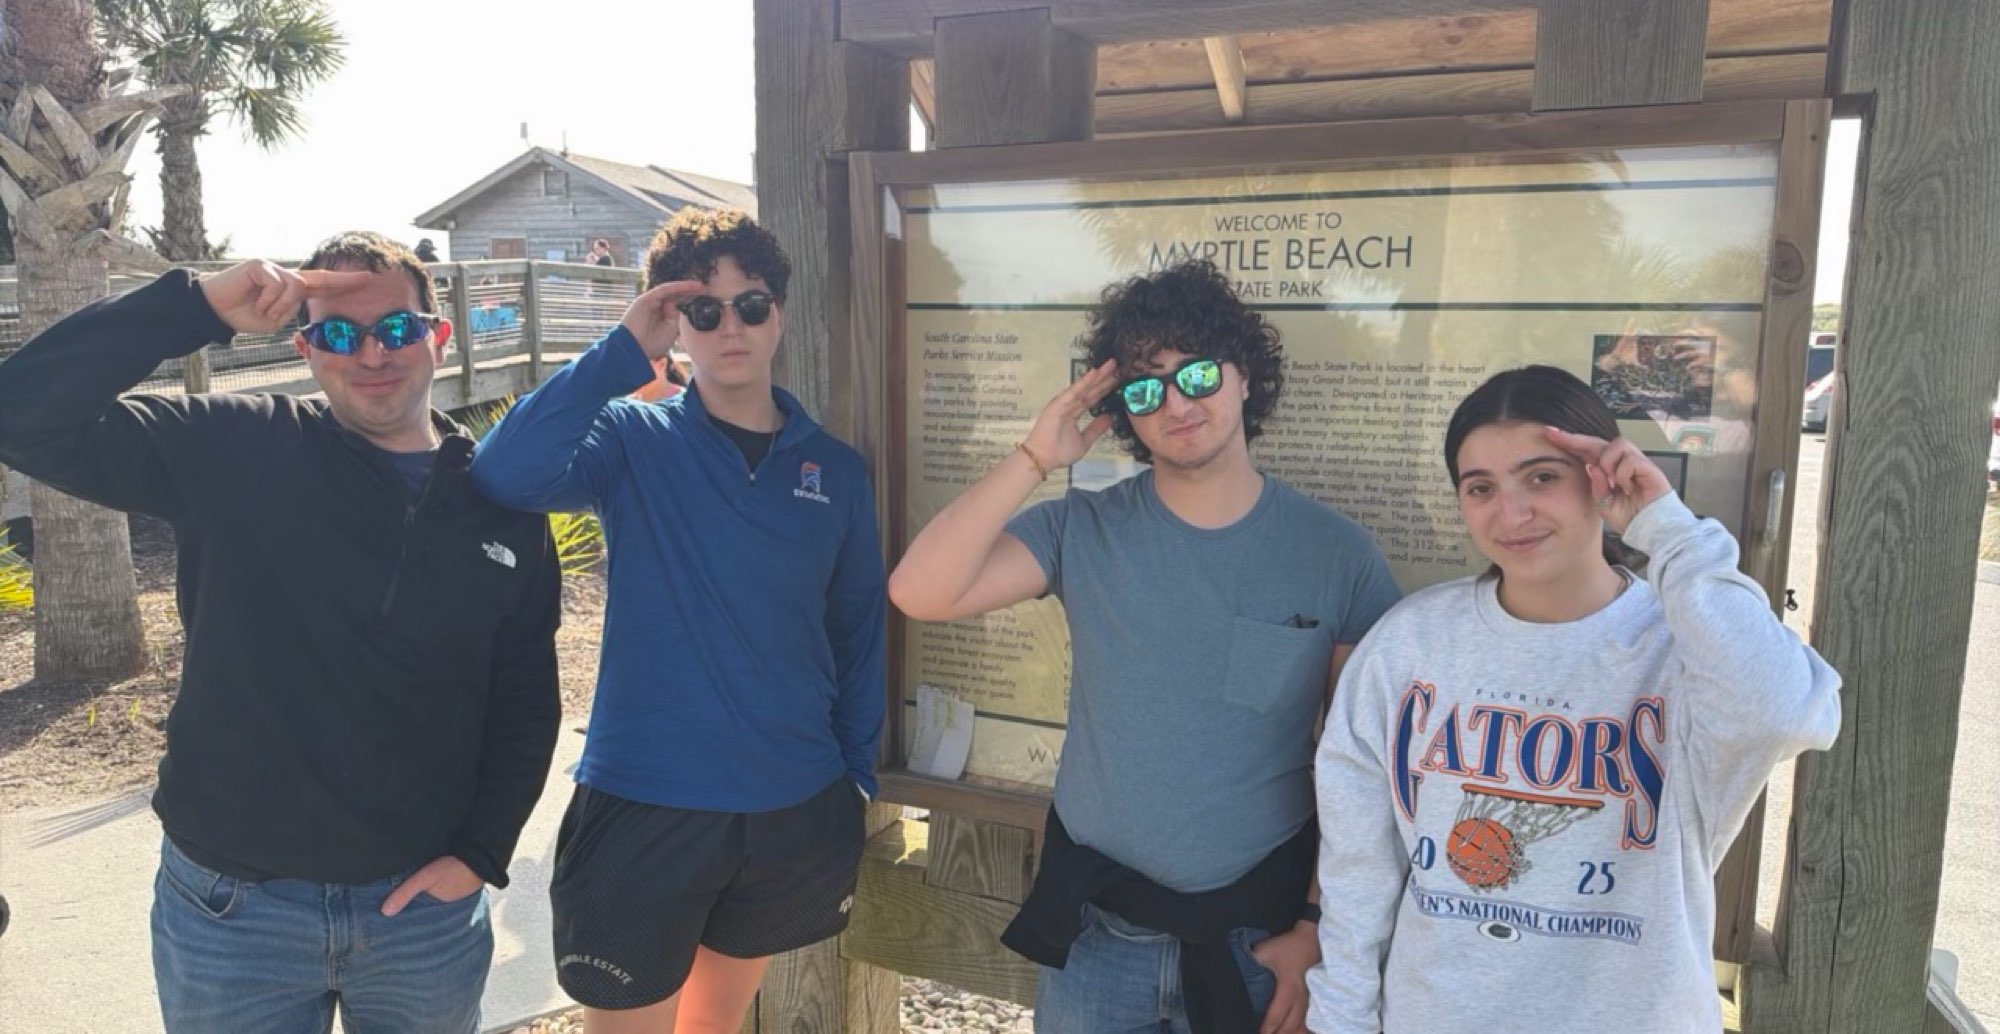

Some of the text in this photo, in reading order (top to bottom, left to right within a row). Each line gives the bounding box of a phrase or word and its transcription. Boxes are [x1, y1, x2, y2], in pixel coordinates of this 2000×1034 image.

[1215, 211, 1343, 232] WELCOME TO
[1285, 234, 1414, 271] BEACH
[1226, 279, 1324, 298] TATE PARK
[925, 332, 1020, 345] South Carolina State
[924, 348, 1023, 362] Parks Service Mission
[1291, 360, 1321, 371] Beach
[1324, 361, 1348, 371] State
[1350, 361, 1371, 372] Park
[1375, 362, 1384, 372] is
[1387, 361, 1423, 373] located
[1426, 362, 1436, 373] in
[1440, 361, 1456, 373] the
[1458, 361, 1486, 374] heart
[934, 371, 975, 382] encourage
[977, 372, 1005, 382] people
[1288, 374, 1310, 386] busy
[1312, 374, 1345, 386] Grand
[1385, 375, 1401, 387] but
[1413, 375, 1431, 388] still
[1433, 377, 1468, 389] retains
[957, 383, 977, 393] South
[982, 384, 1023, 395] Carolina's
[1332, 388, 1387, 402] Designated
[1400, 389, 1443, 403] Heritage
[943, 397, 965, 407] parks
[966, 397, 977, 409] by
[979, 399, 1018, 410] providing
[1280, 401, 1295, 410] the
[1297, 402, 1326, 413] park's
[1329, 403, 1370, 412] maritime
[1374, 402, 1401, 413] forest
[1437, 404, 1451, 417] by
[923, 422, 938, 431] and
[1299, 416, 1312, 425] an
[1315, 415, 1360, 428] important
[1363, 415, 1400, 430] feeding
[1402, 418, 1423, 428] and
[1286, 426, 1299, 437] for
[1302, 429, 1328, 440] many
[1331, 429, 1377, 442] migratory
[1277, 441, 1313, 452] protects
[1326, 441, 1369, 455] relatively
[1371, 443, 1435, 457] undeveloped
[1255, 449, 1276, 464] long
[1279, 453, 1310, 464] section
[1313, 452, 1323, 465] of
[1326, 453, 1349, 466] sand
[1351, 456, 1381, 468] dunes
[1383, 457, 1404, 468] and
[1284, 466, 1320, 477] provide
[1323, 467, 1354, 478] critical
[1357, 471, 1392, 483] nesting
[1394, 471, 1429, 483] habitat
[1432, 472, 1446, 484] for
[1304, 481, 1325, 490] state
[1364, 484, 1379, 493] the
[1382, 484, 1438, 498] loggerhead
[1317, 495, 1350, 505] marine
[1353, 496, 1388, 507] wildlife
[1390, 499, 1409, 509] can
[1412, 499, 1425, 510] be
[1391, 510, 1409, 521] The
[1411, 513, 1442, 525] park's
[1377, 525, 1410, 538] quality
[1391, 536, 1409, 548] This
[1388, 552, 1409, 562] and
[1411, 554, 1434, 566] year
[951, 622, 987, 632] resources
[990, 624, 1000, 634] of
[1001, 626, 1014, 635] the
[922, 631, 952, 641] educate
[954, 632, 968, 642] the
[994, 638, 1016, 648] about
[1020, 641, 1034, 651] the
[922, 654, 937, 664] and
[1476, 687, 1572, 710] FLORIDA
[1392, 679, 1666, 851] GATORS
[1577, 860, 1617, 896] 25
[1419, 892, 1643, 941] EN'S NATIONAL CHAMPIONS
[593, 958, 635, 985] ESTATE
